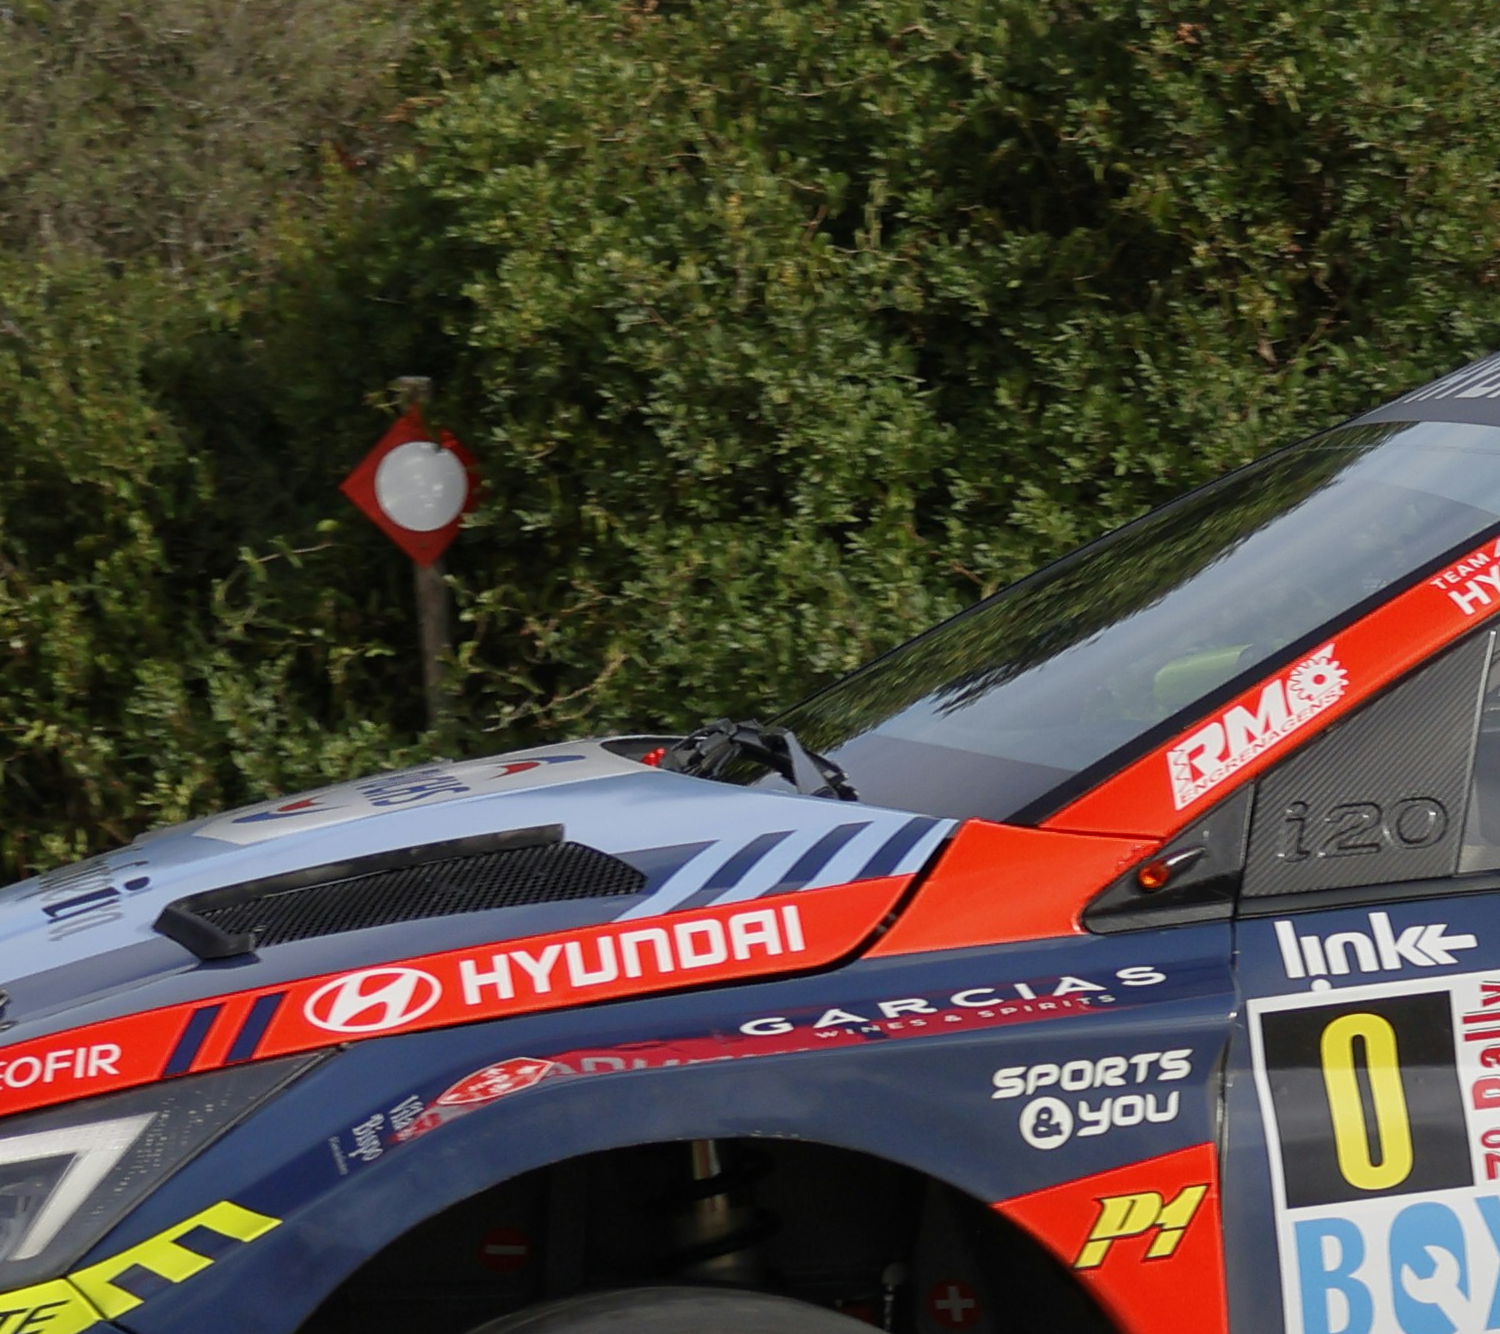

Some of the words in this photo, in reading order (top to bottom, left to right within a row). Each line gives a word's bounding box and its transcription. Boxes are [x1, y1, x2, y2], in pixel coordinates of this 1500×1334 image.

[1430, 553, 1491, 590] TEAM
[1180, 690, 1340, 804] ENGRENAGENS
[1278, 797, 1448, 862] i20
[458, 904, 805, 1006] HYUNDAI
[738, 966, 1167, 1037] GARCIAS
[814, 1018, 925, 1040] WINES
[978, 994, 1117, 1020] SPIRITS
[991, 1049, 1193, 1100] SPORTS
[1320, 1013, 1414, 1191] 0
[1076, 1090, 1180, 1137] YOU
[1073, 1184, 1208, 1270] P1
